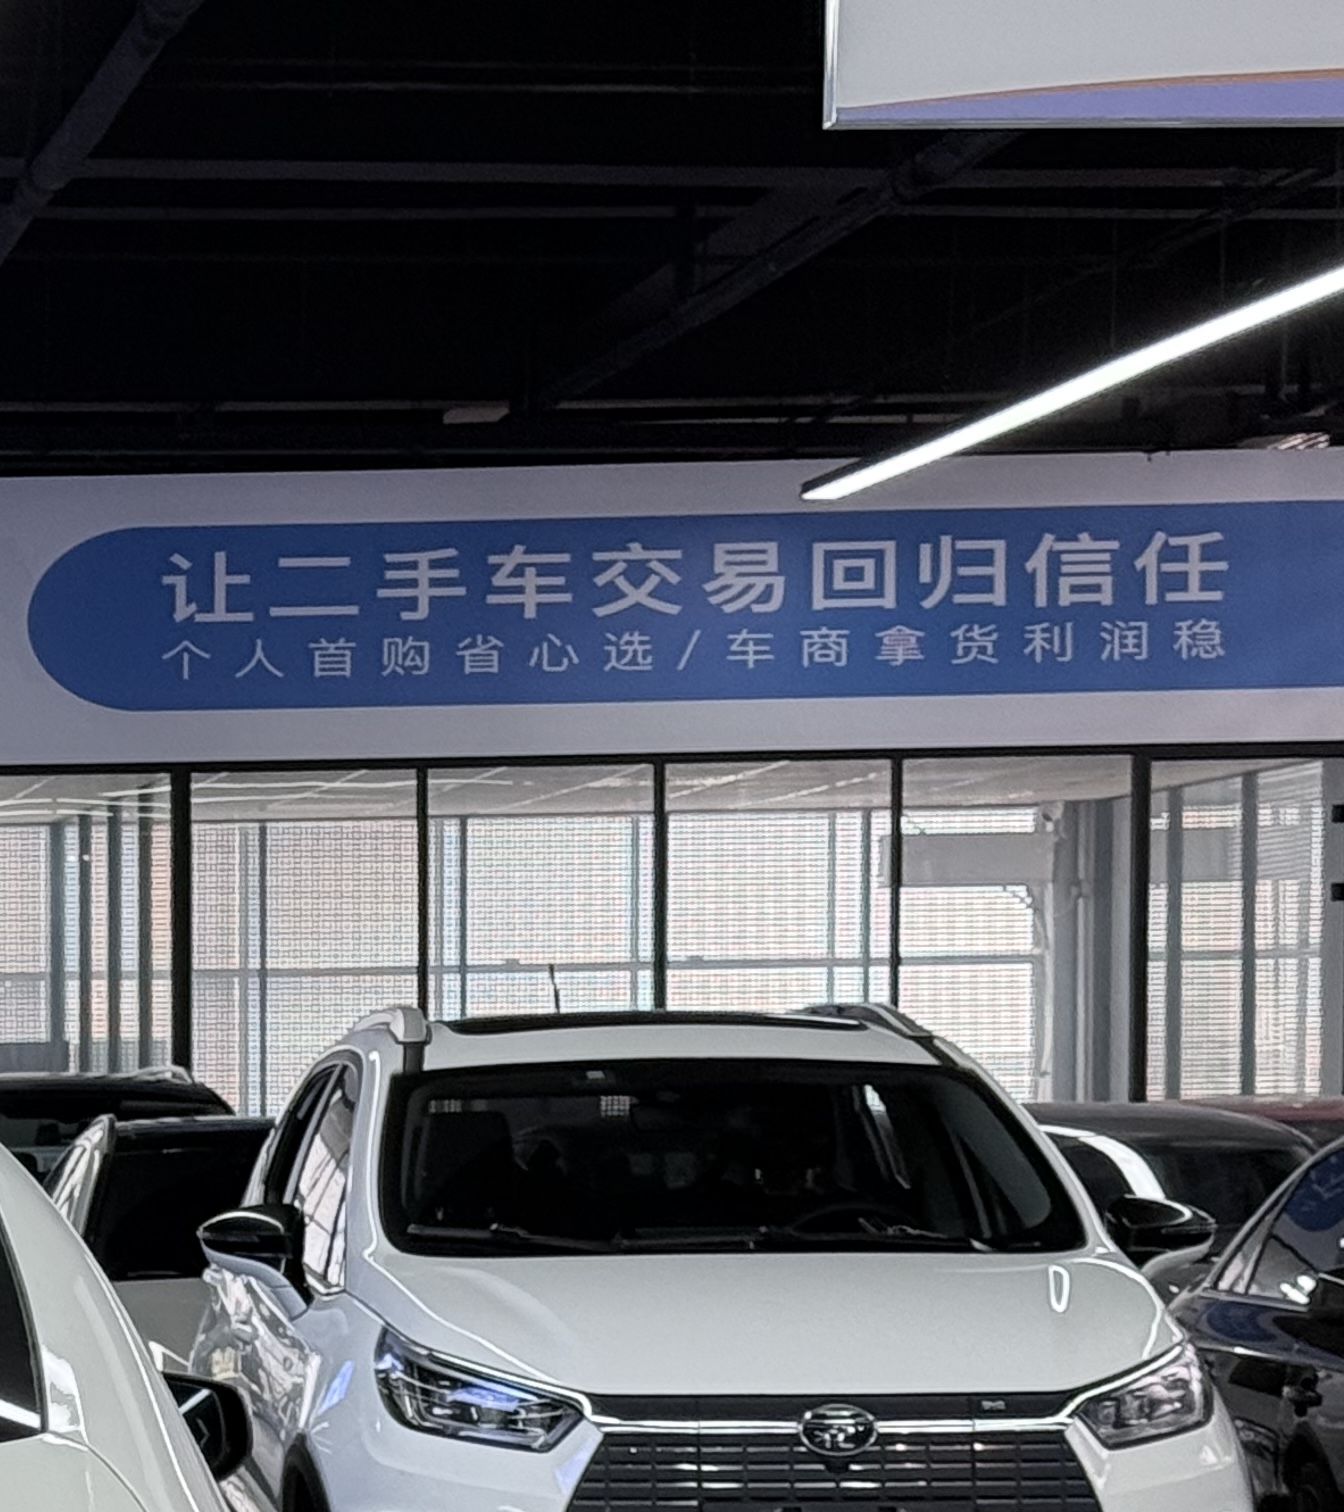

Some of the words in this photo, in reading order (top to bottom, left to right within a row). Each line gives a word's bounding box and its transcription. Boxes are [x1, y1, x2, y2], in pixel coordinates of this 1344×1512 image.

[161, 530, 1232, 627] 让二手车交易回归信任
